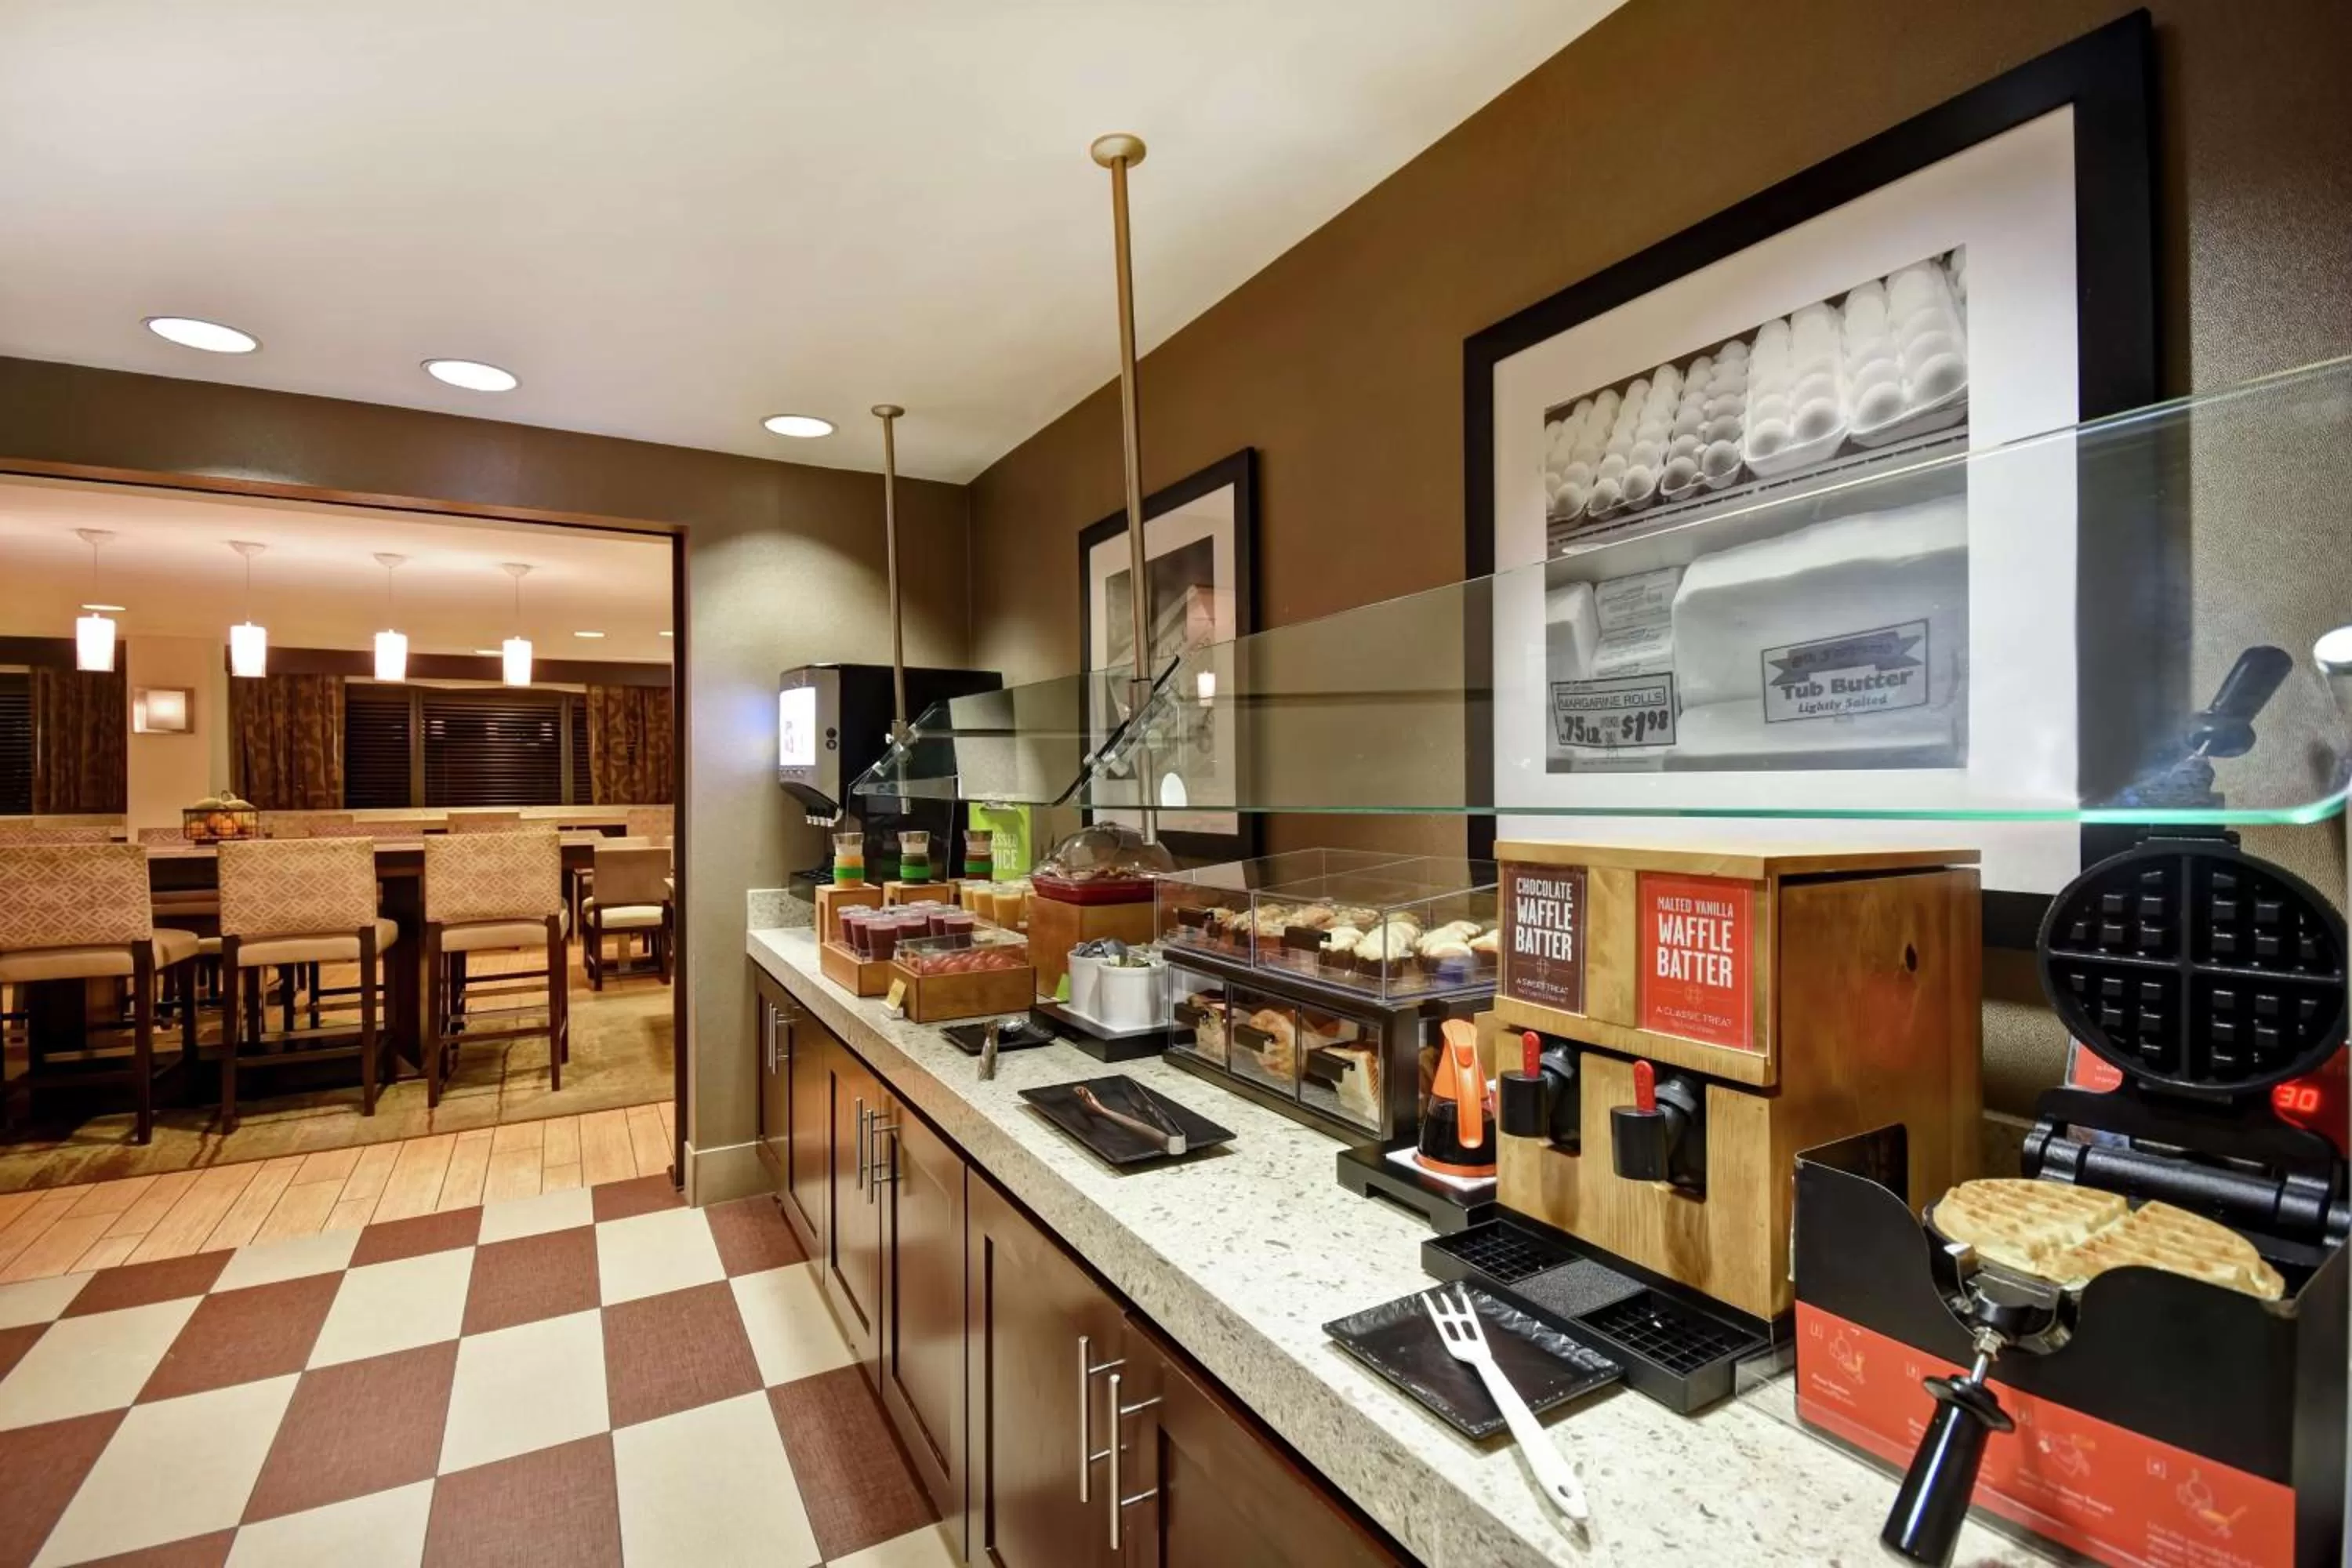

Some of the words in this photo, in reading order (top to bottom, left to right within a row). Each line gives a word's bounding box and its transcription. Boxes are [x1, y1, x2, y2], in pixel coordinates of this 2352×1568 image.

[1781, 681, 1824, 700] Tub
[1831, 670, 1914, 695] Butter
[1559, 695, 1621, 709] MARGARINE
[1624, 691, 1663, 706] ROLLS
[1798, 698, 1842, 714] Lightly
[1515, 877, 1573, 902] CHOCOLATE
[1515, 896, 1574, 931] WAFFLE
[1657, 895, 1693, 914] MALTED
[1695, 899, 1733, 919] VANILLA
[1515, 927, 1573, 962] BATTER
[1657, 913, 1733, 953] WAFFLE
[1657, 946, 1733, 989] BATTER
[1664, 1006, 1701, 1022] CLASSIC
[1702, 1013, 1732, 1027] TREAT
[2277, 1085, 2319, 1112] 30
